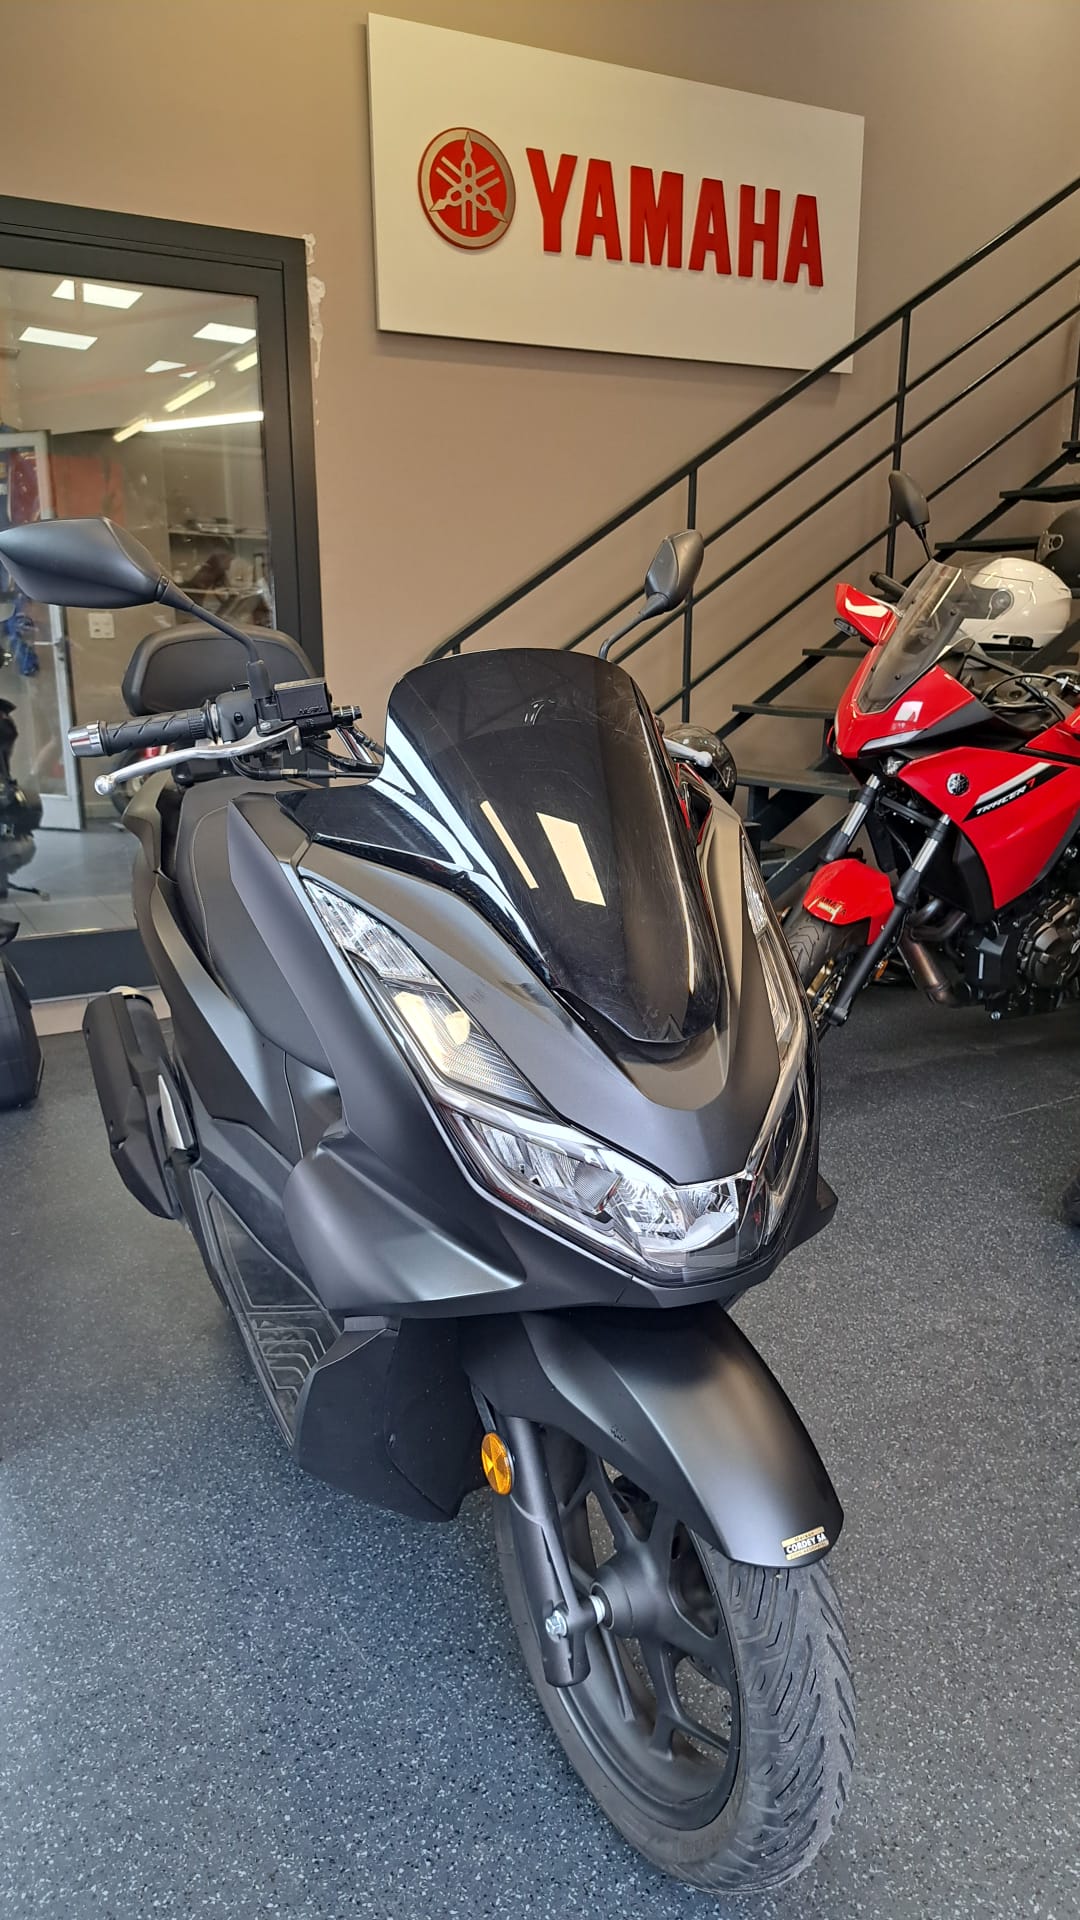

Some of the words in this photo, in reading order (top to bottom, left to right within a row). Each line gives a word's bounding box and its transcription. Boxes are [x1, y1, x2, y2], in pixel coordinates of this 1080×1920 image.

[526, 148, 823, 287] YAMAHA
[976, 785, 1027, 815] TRACER
[786, 1537, 817, 1554] CORDEY
[816, 1532, 827, 1543] SA
